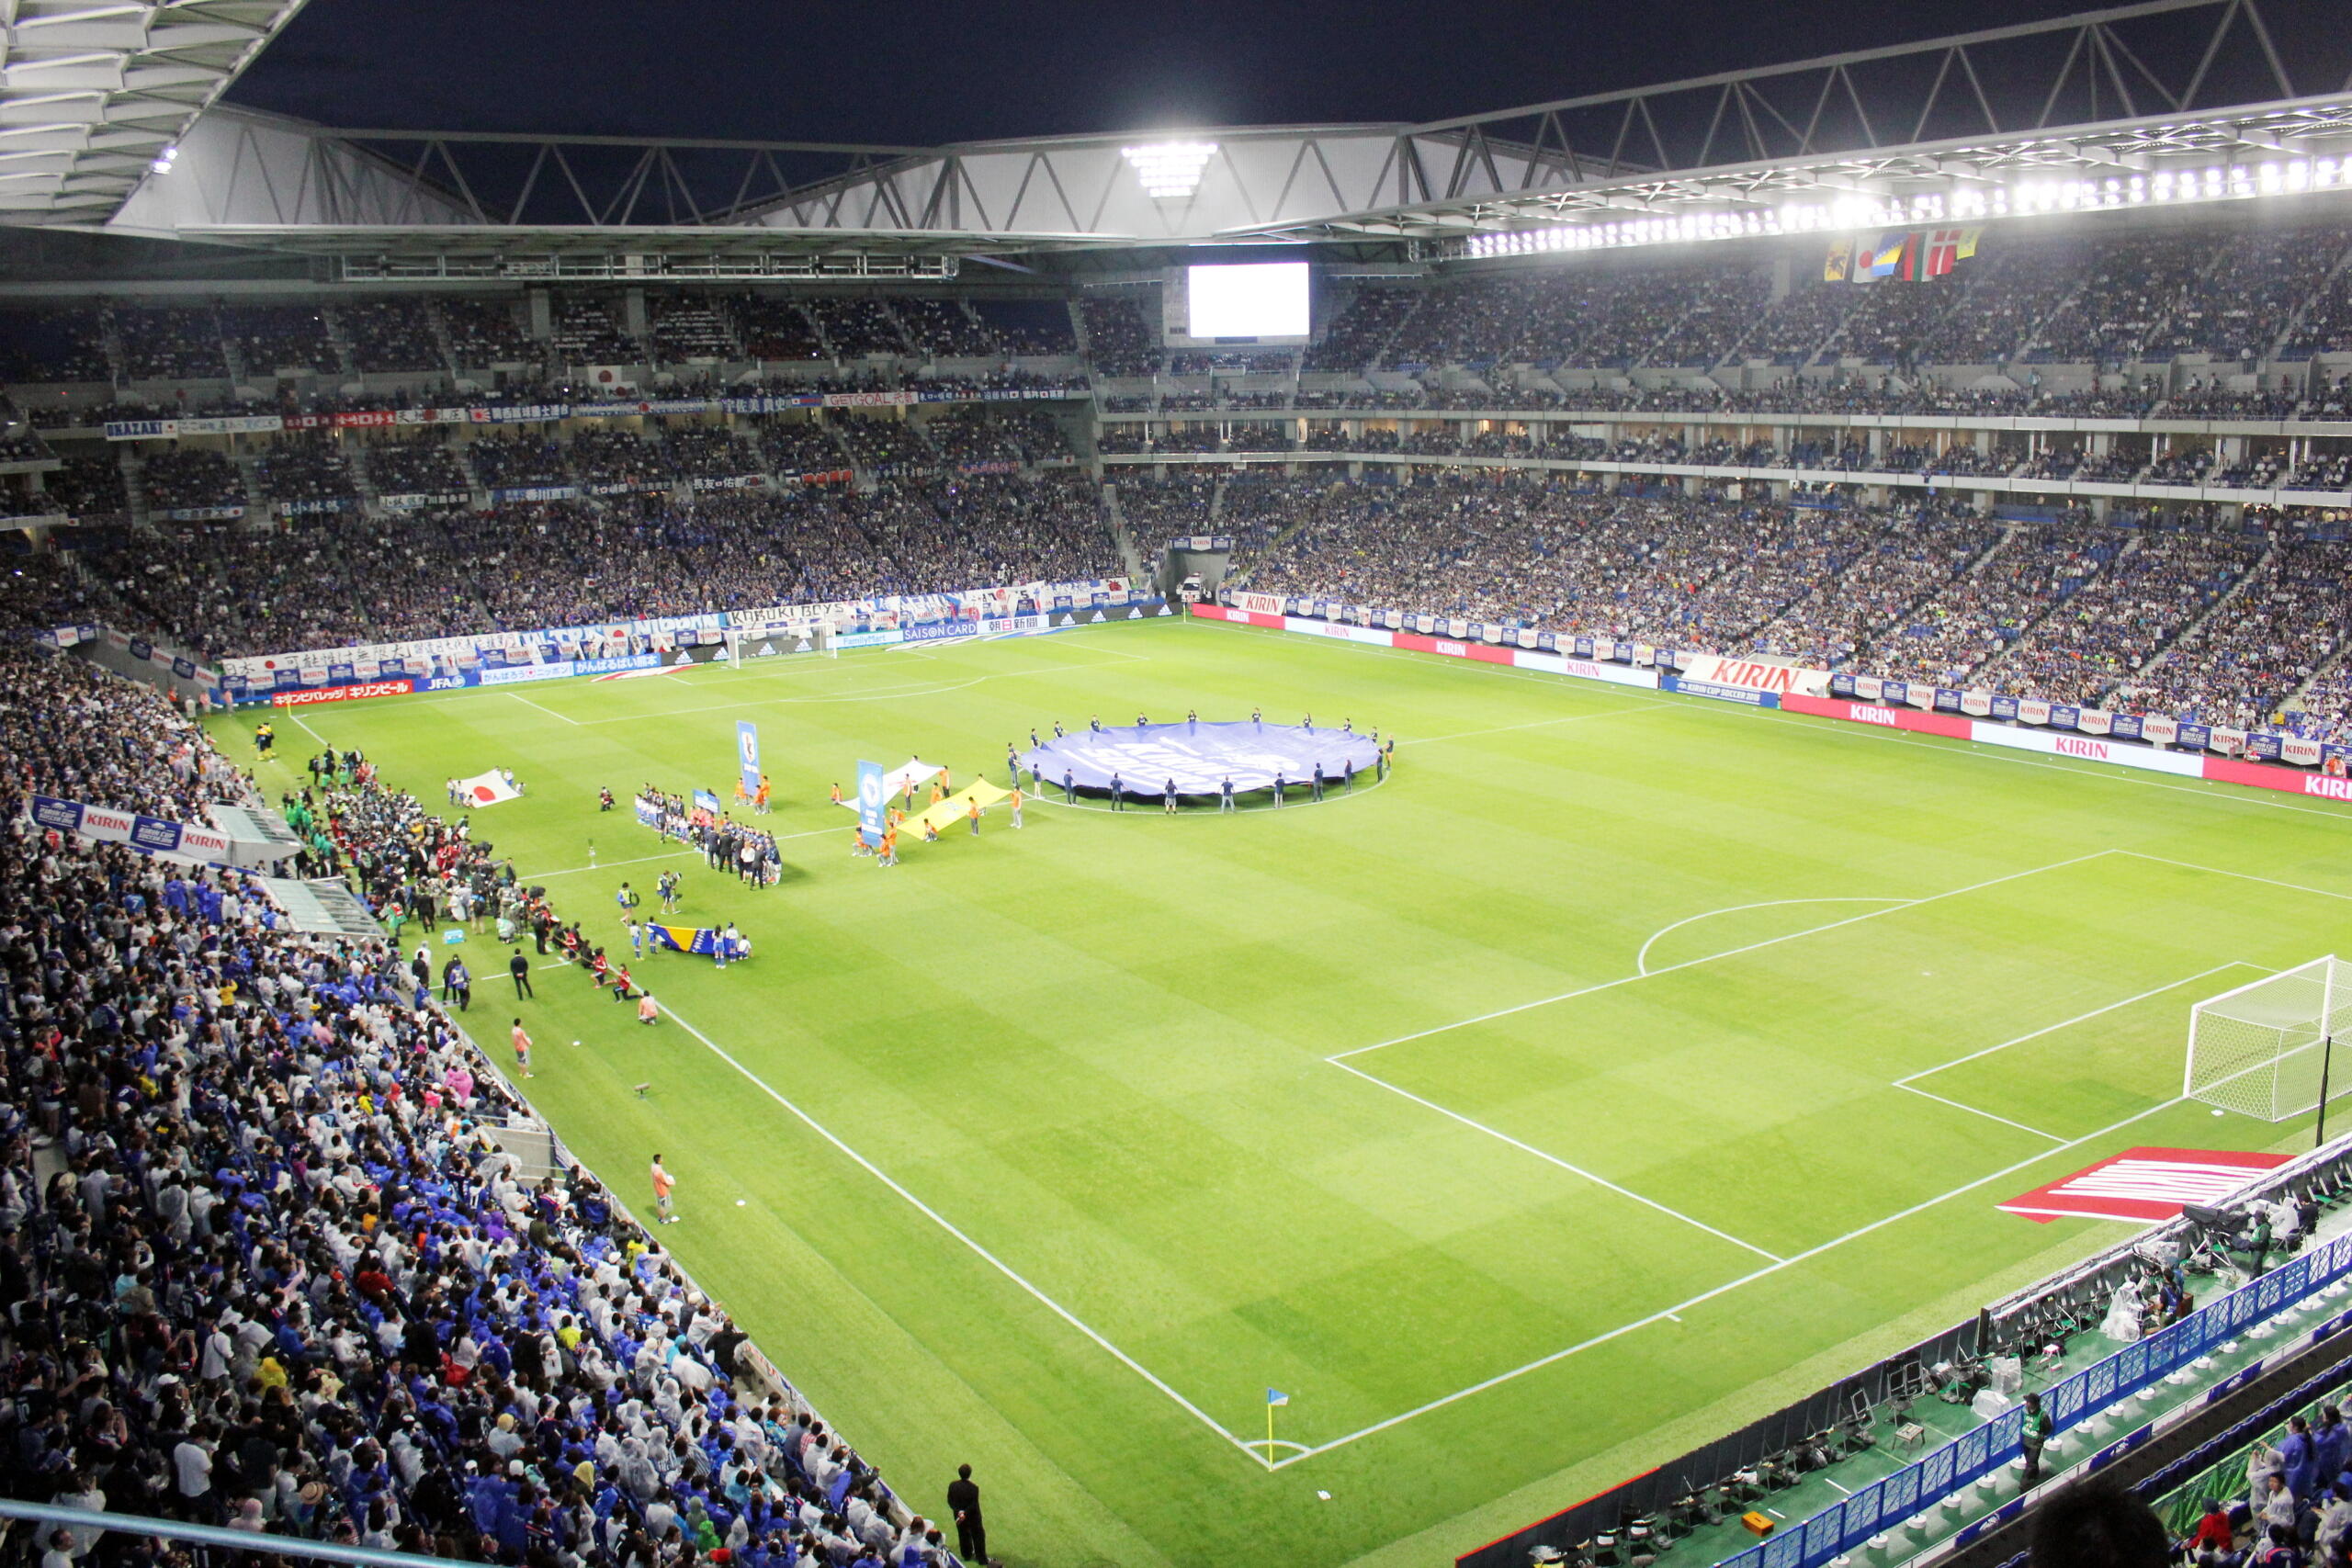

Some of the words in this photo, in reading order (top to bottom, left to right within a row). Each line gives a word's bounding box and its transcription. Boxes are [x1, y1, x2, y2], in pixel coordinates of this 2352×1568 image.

[831, 396, 856, 406] GET
[858, 393, 890, 405] GOAL
[107, 422, 163, 437] OKAZAKI
[801, 603, 843, 617] BOYS
[1246, 595, 1280, 613] KIRIN
[1227, 609, 1250, 623] KIRIN
[989, 616, 1038, 631] 朝日新聞
[904, 627, 945, 640] SAISON
[947, 623, 977, 636] CARD
[1325, 626, 1350, 637] KIRIN
[843, 634, 886, 645] FamilyMart
[1436, 641, 1466, 657] KIRIN
[1566, 662, 1600, 677] KIRIN
[1711, 660, 1801, 693] KIRIN
[349, 682, 408, 698] キリンビール
[427, 678, 453, 690] JFA
[1688, 683, 1706, 694] KIRIN
[1707, 686, 1721, 695] CUP
[1858, 682, 1880, 692] KIRIN
[1963, 697, 1987, 708] KIRIN
[1850, 704, 1895, 726] KIRIN
[2021, 705, 2046, 716] KIRIN
[2081, 715, 2109, 727] KIRIN
[2145, 724, 2174, 736] KIRIN
[2056, 736, 2109, 760] KIRIN
[2285, 744, 2316, 757] KIRIN
[87, 814, 130, 831] KIRIN
[186, 833, 225, 850] KIRIN
